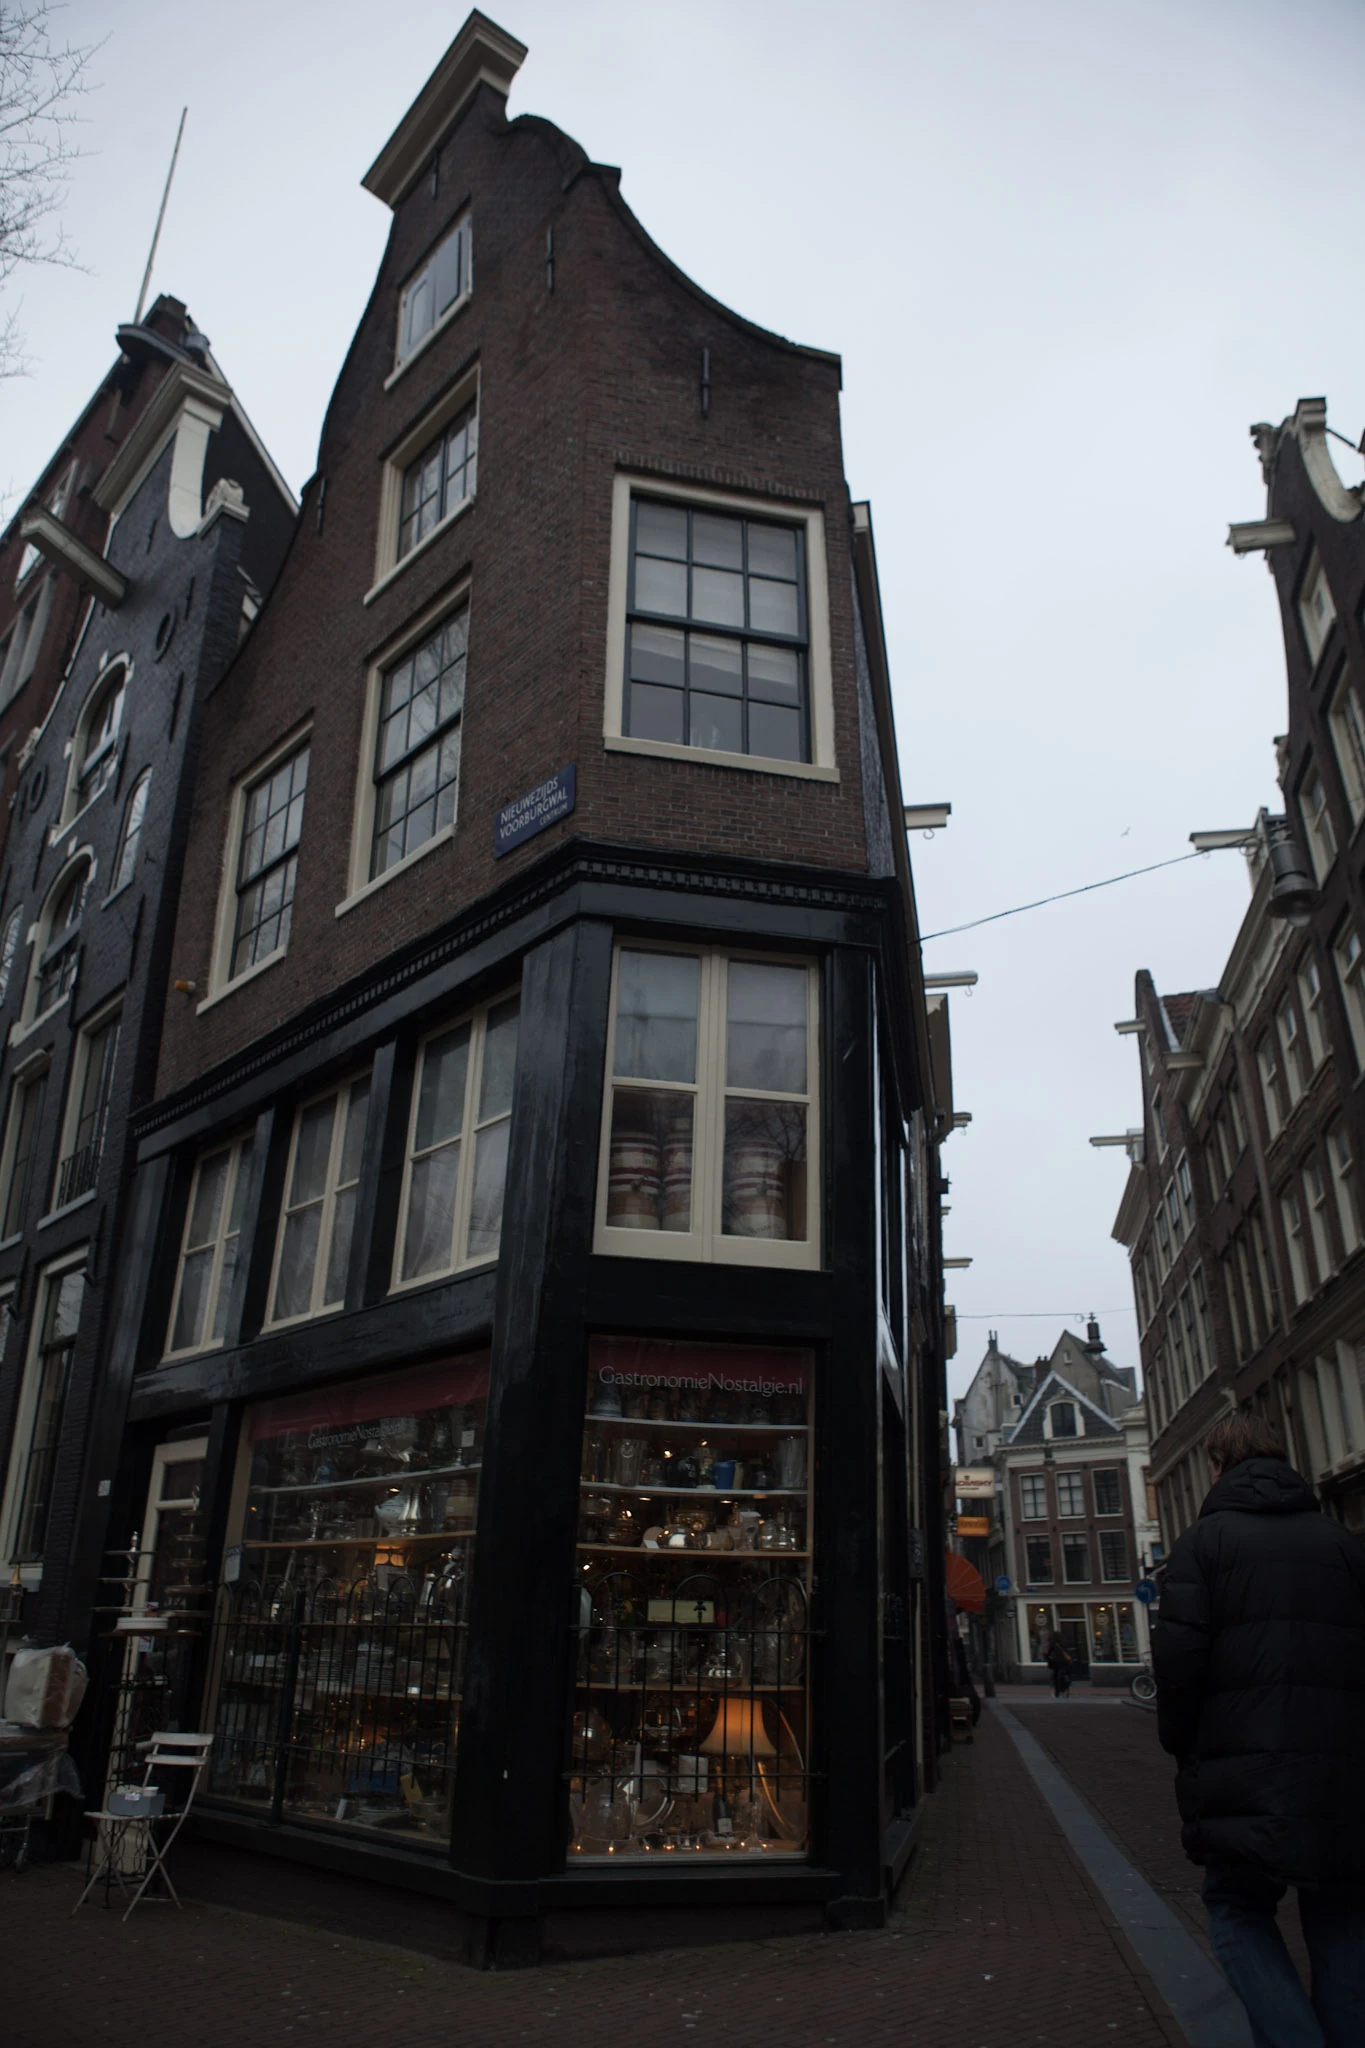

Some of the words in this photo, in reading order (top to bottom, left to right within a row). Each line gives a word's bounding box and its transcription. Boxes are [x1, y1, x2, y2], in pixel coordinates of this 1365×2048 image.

[499, 787, 568, 839] VOORBURGWAL
[500, 776, 558, 825] NIEUWEZIJDS
[539, 802, 568, 826] CENTRUM
[598, 1365, 803, 1398] GastronomieNostalgie.nl
